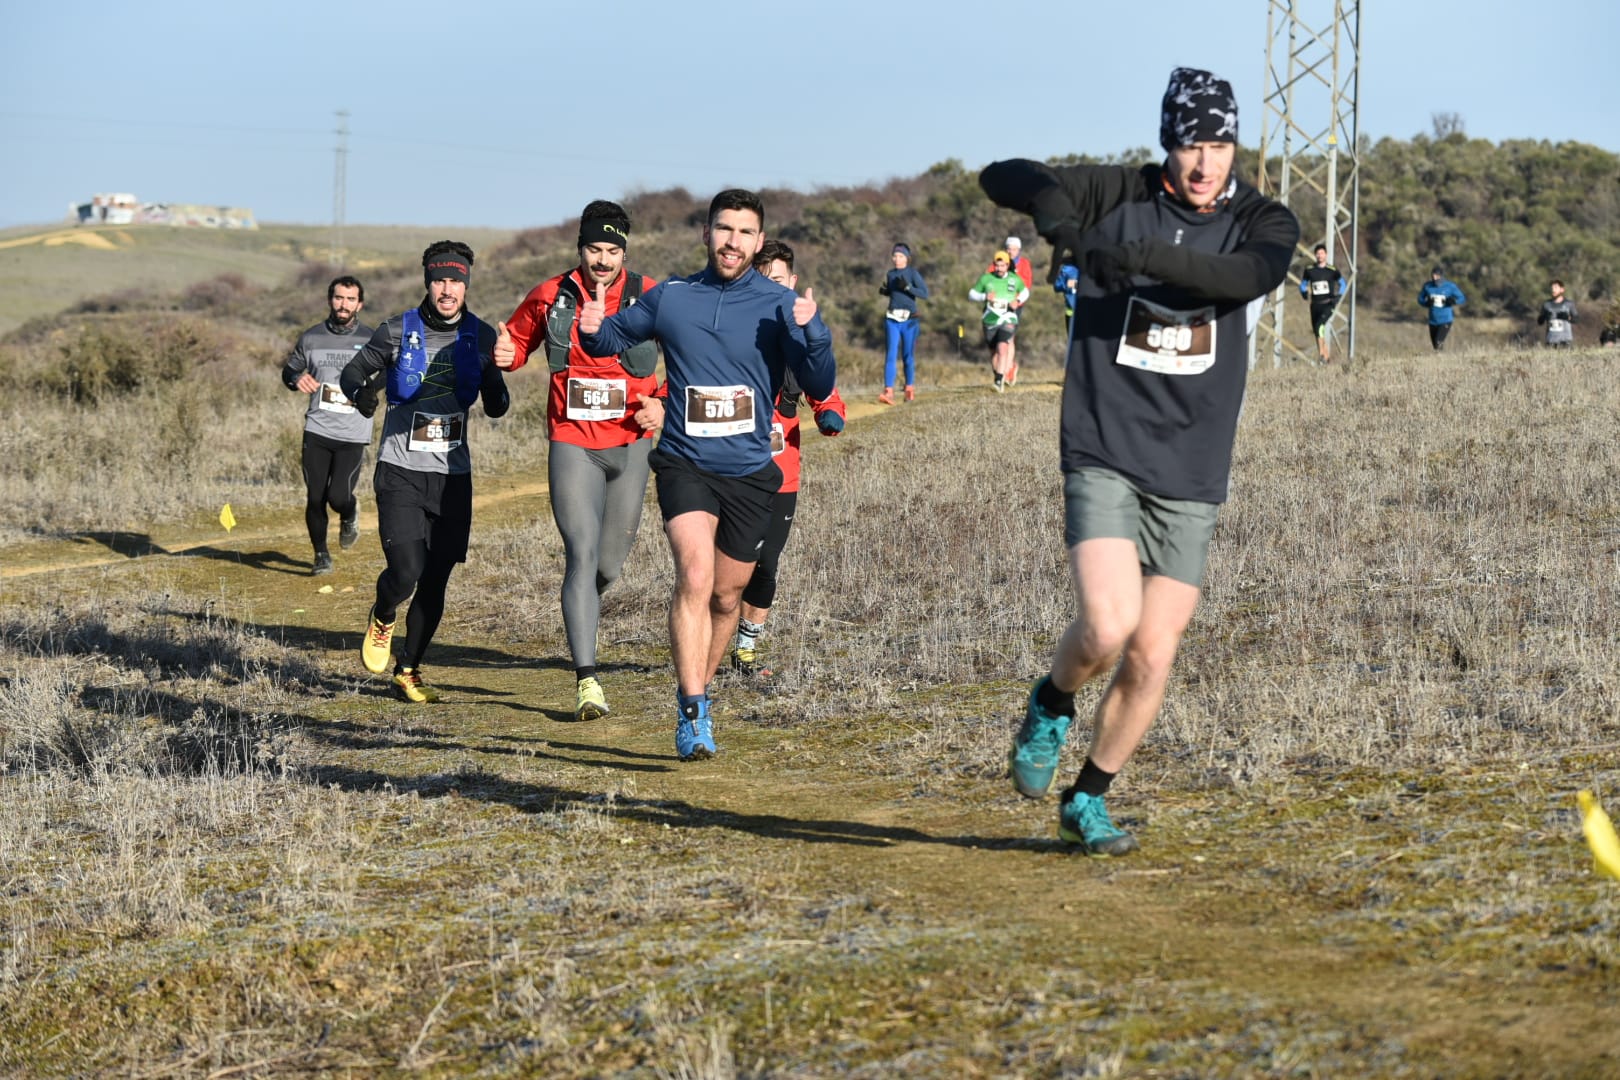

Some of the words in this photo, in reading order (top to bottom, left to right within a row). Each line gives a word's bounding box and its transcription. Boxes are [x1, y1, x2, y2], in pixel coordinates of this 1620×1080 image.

[1147, 323, 1192, 351] 560
[318, 360, 347, 368] CANDA
[326, 353, 353, 361] TRANS
[583, 390, 609, 406] 564
[705, 400, 735, 418] 576
[427, 424, 451, 439] 558
